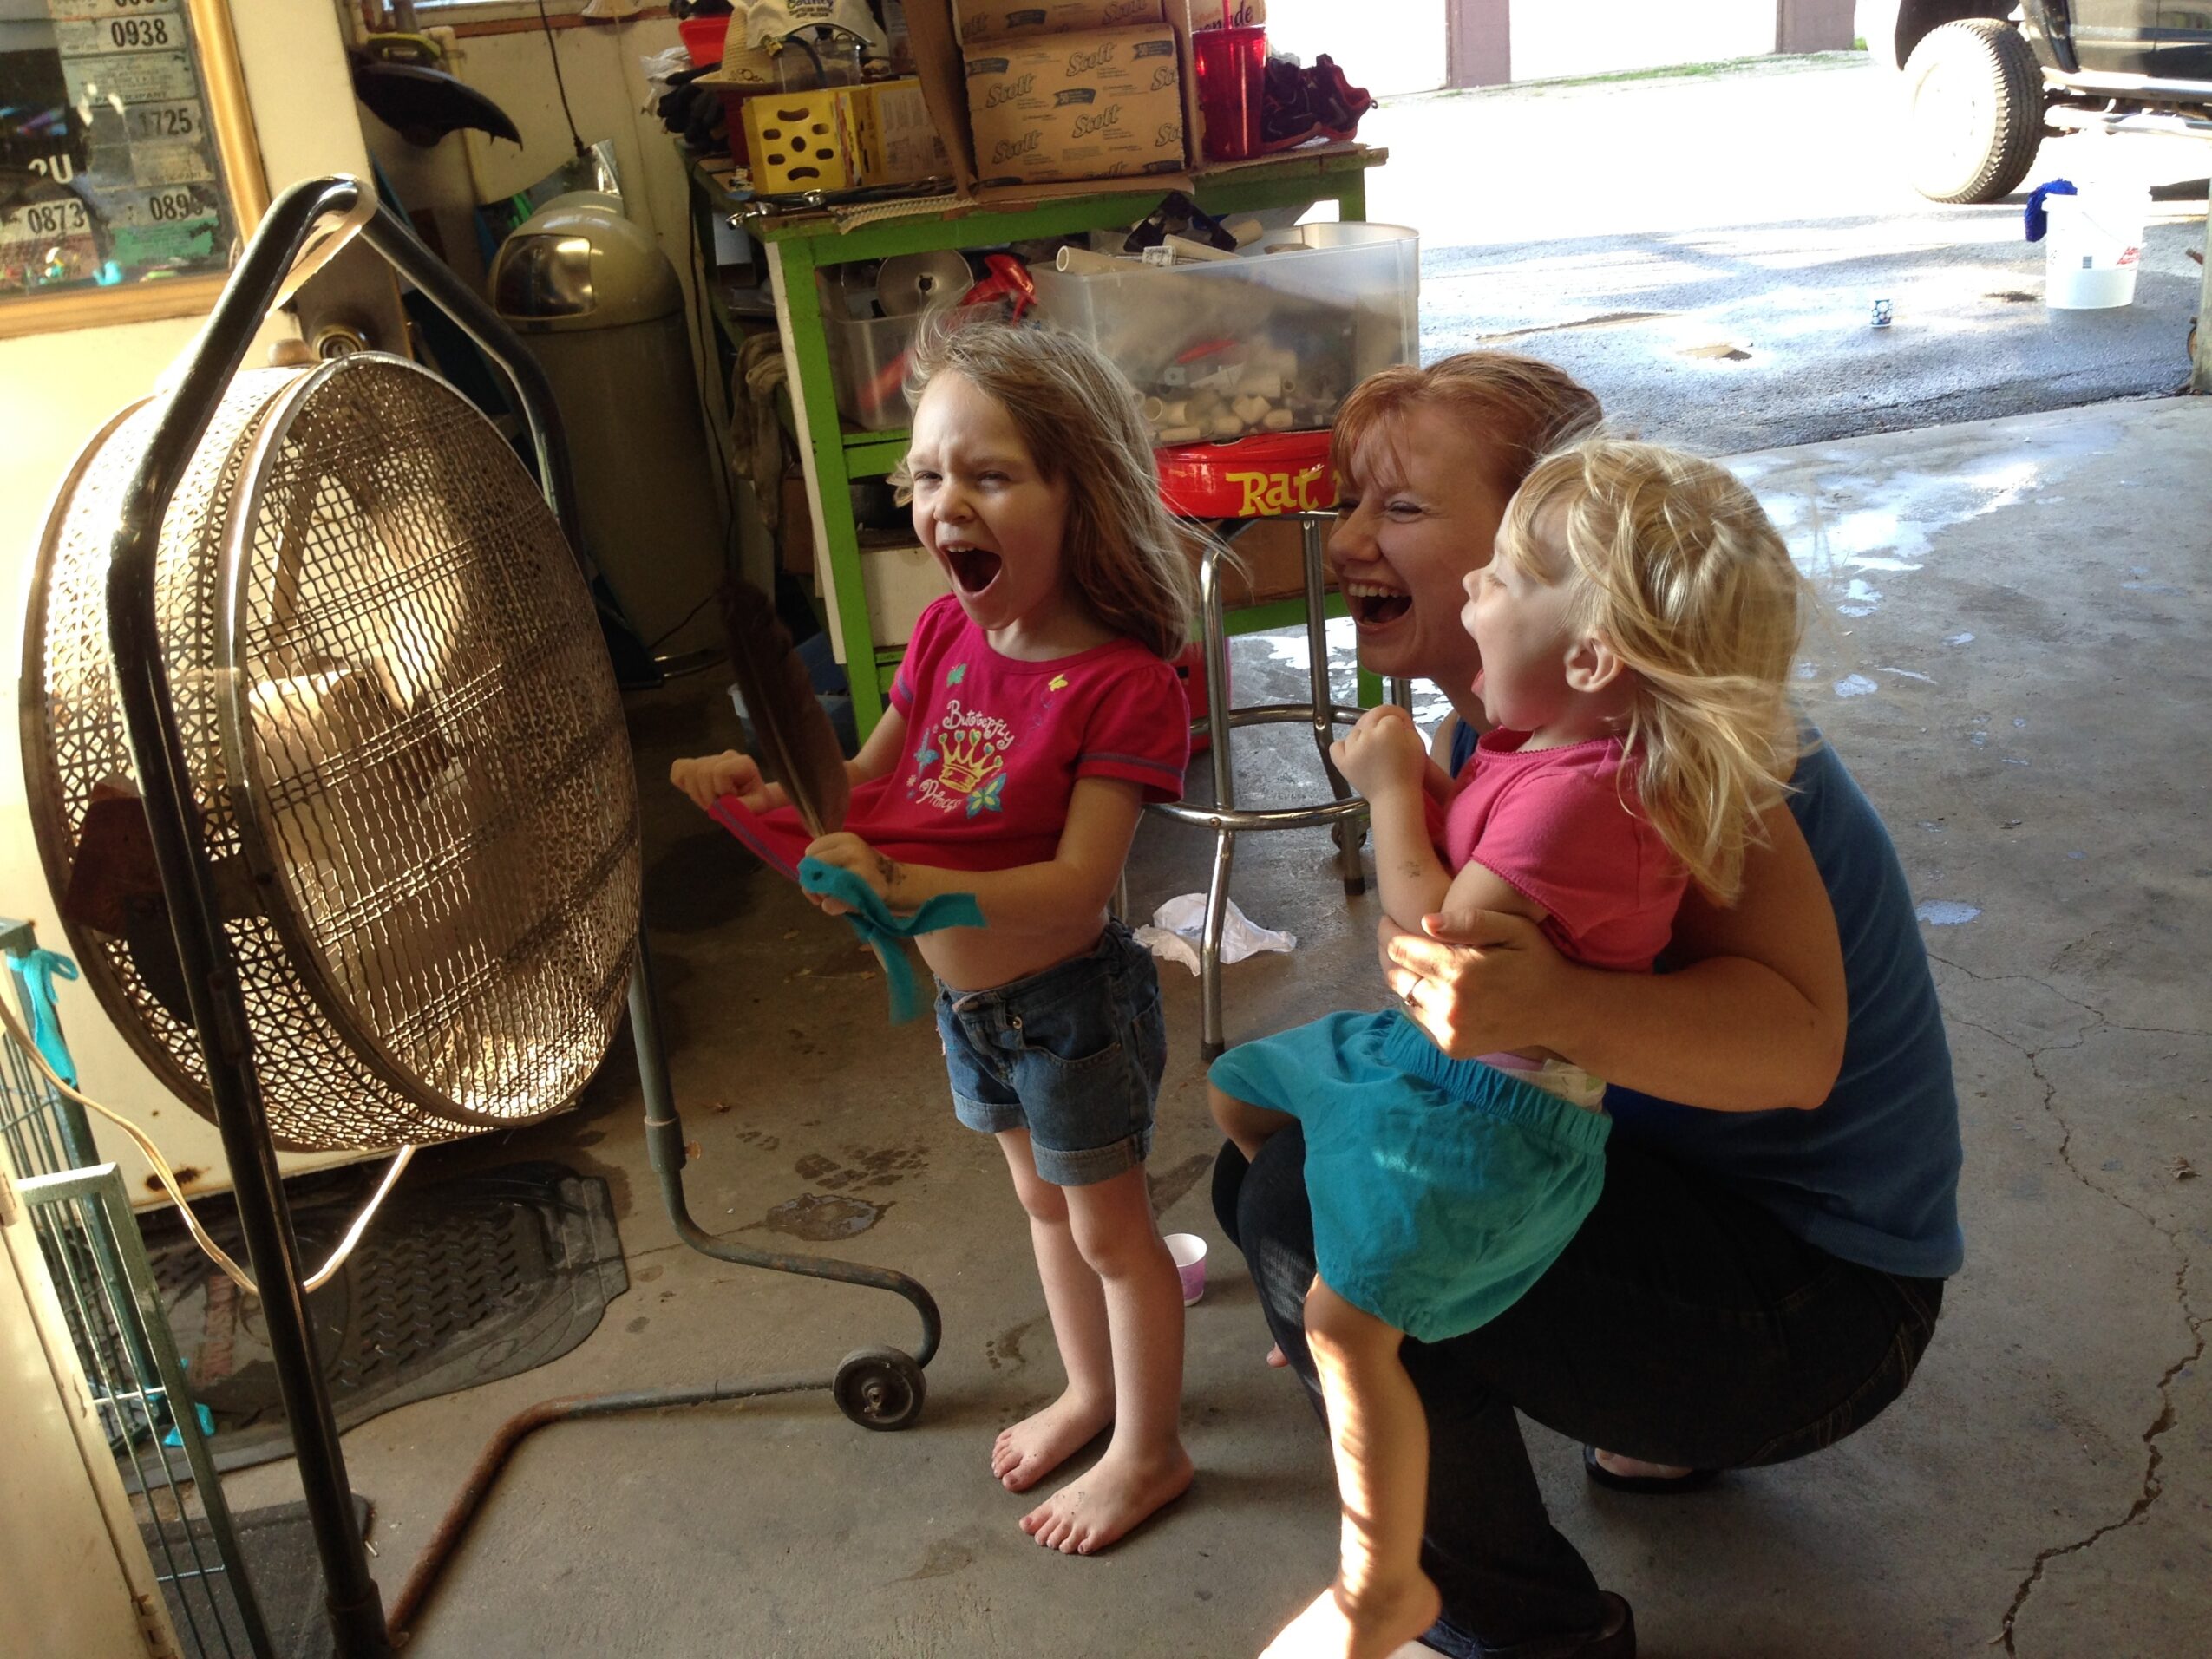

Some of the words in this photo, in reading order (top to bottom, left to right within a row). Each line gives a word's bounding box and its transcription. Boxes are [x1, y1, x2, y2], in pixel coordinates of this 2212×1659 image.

[111, 18, 168, 48] 0938
[1066, 42, 1116, 77] Scott
[985, 72, 1037, 108] Scott
[139, 108, 193, 136] 1725
[1071, 103, 1122, 139] Scott
[991, 129, 1043, 165] Scott
[28, 201, 85, 234] 0873
[1225, 468, 1325, 518] Rat
[942, 699, 1015, 750] Butterfly
